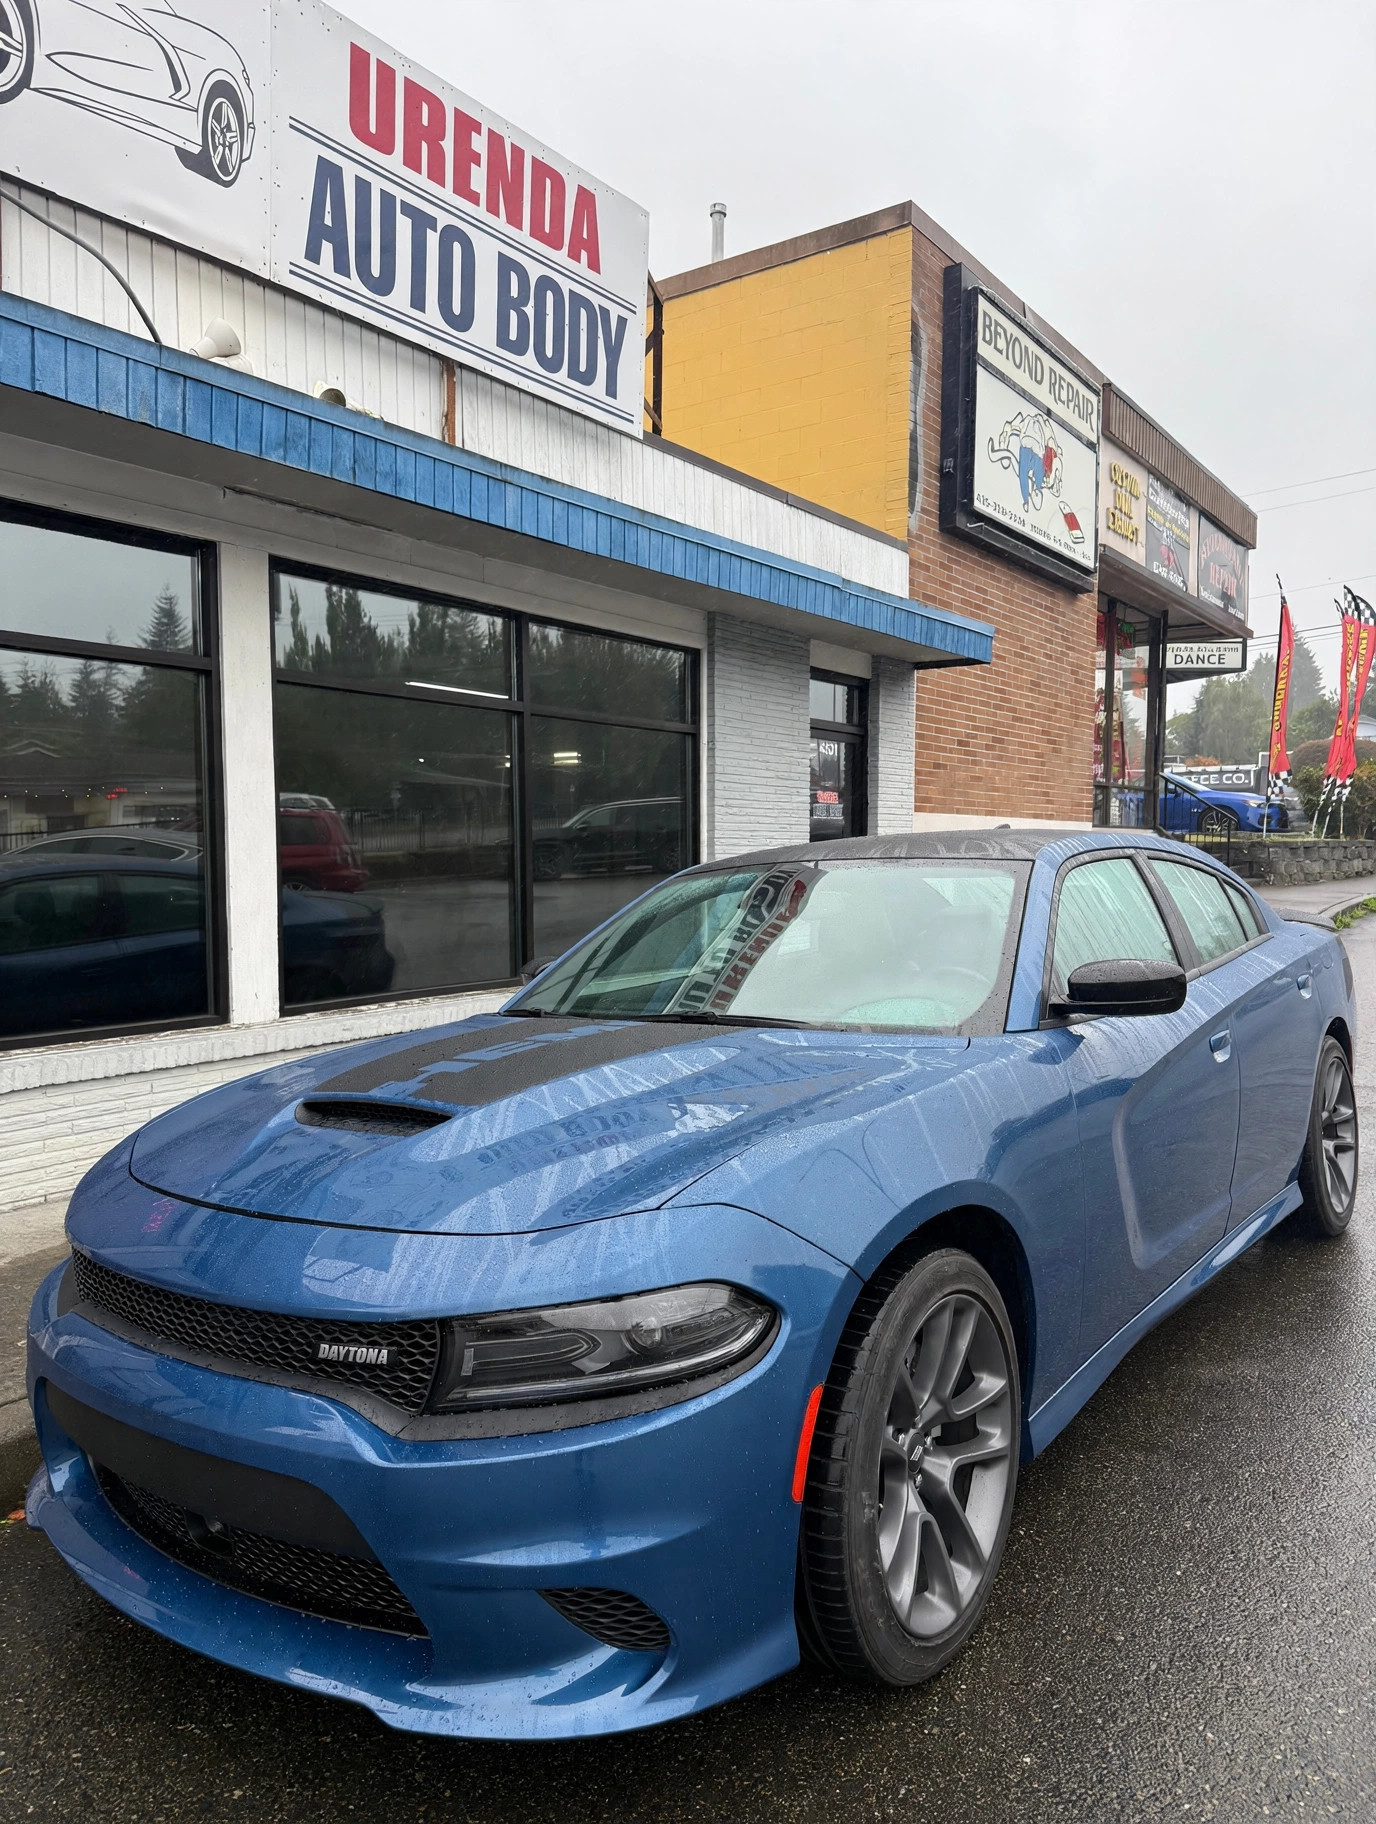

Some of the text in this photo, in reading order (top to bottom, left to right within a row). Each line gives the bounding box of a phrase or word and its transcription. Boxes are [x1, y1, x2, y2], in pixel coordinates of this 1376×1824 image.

[349, 41, 601, 276] URENDA
[304, 154, 628, 401] AUTO BODY
[982, 309, 1096, 433] BEYOND REPAIR
[1174, 654, 1226, 665] DANCE
[1222, 773, 1249, 784] CO.
[317, 1343, 388, 1365] DAYTONA
